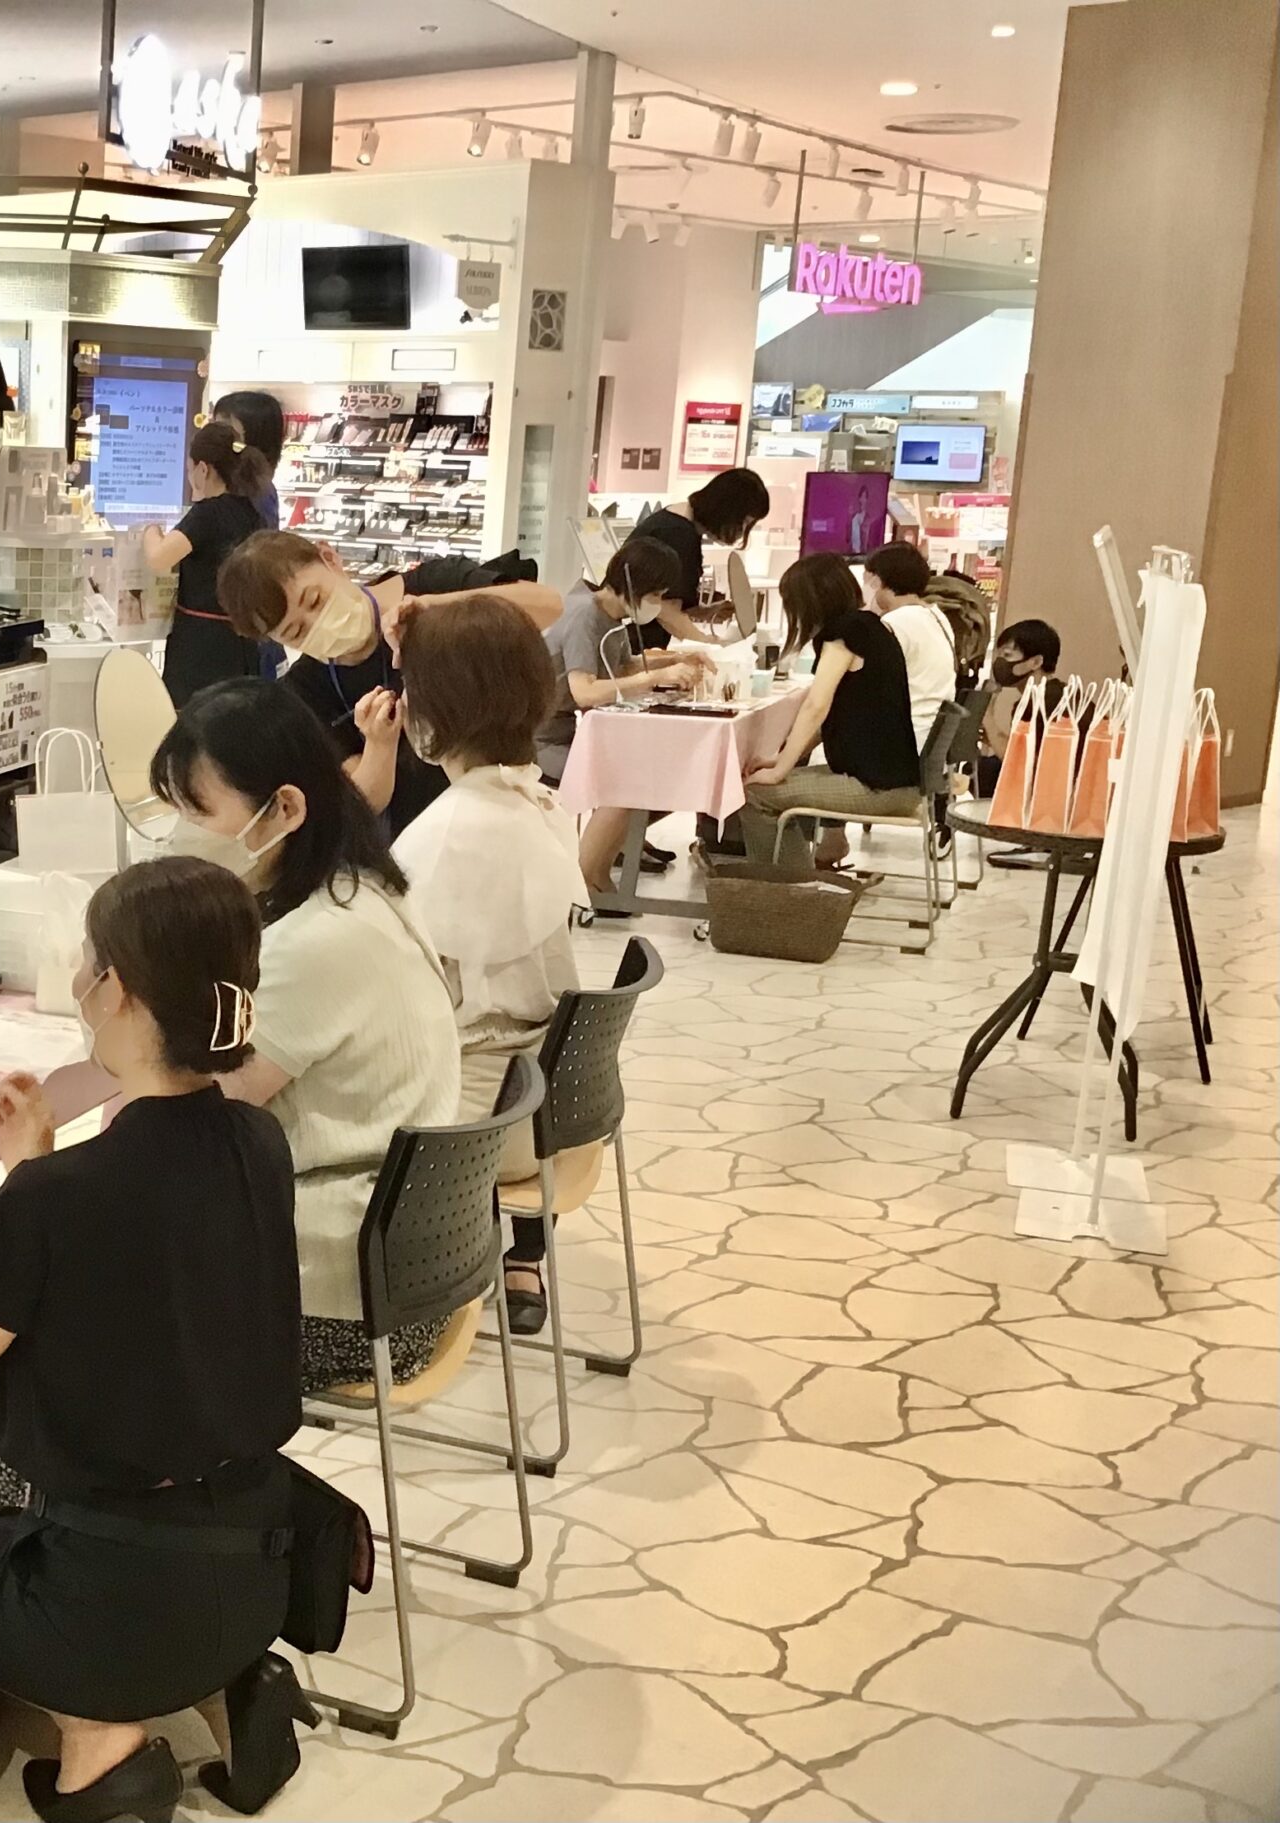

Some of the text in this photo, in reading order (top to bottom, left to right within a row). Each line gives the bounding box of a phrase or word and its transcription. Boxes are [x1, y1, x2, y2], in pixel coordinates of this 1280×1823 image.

[796, 242, 921, 305] Rakuten
[339, 395, 402, 409] カラーマスク
